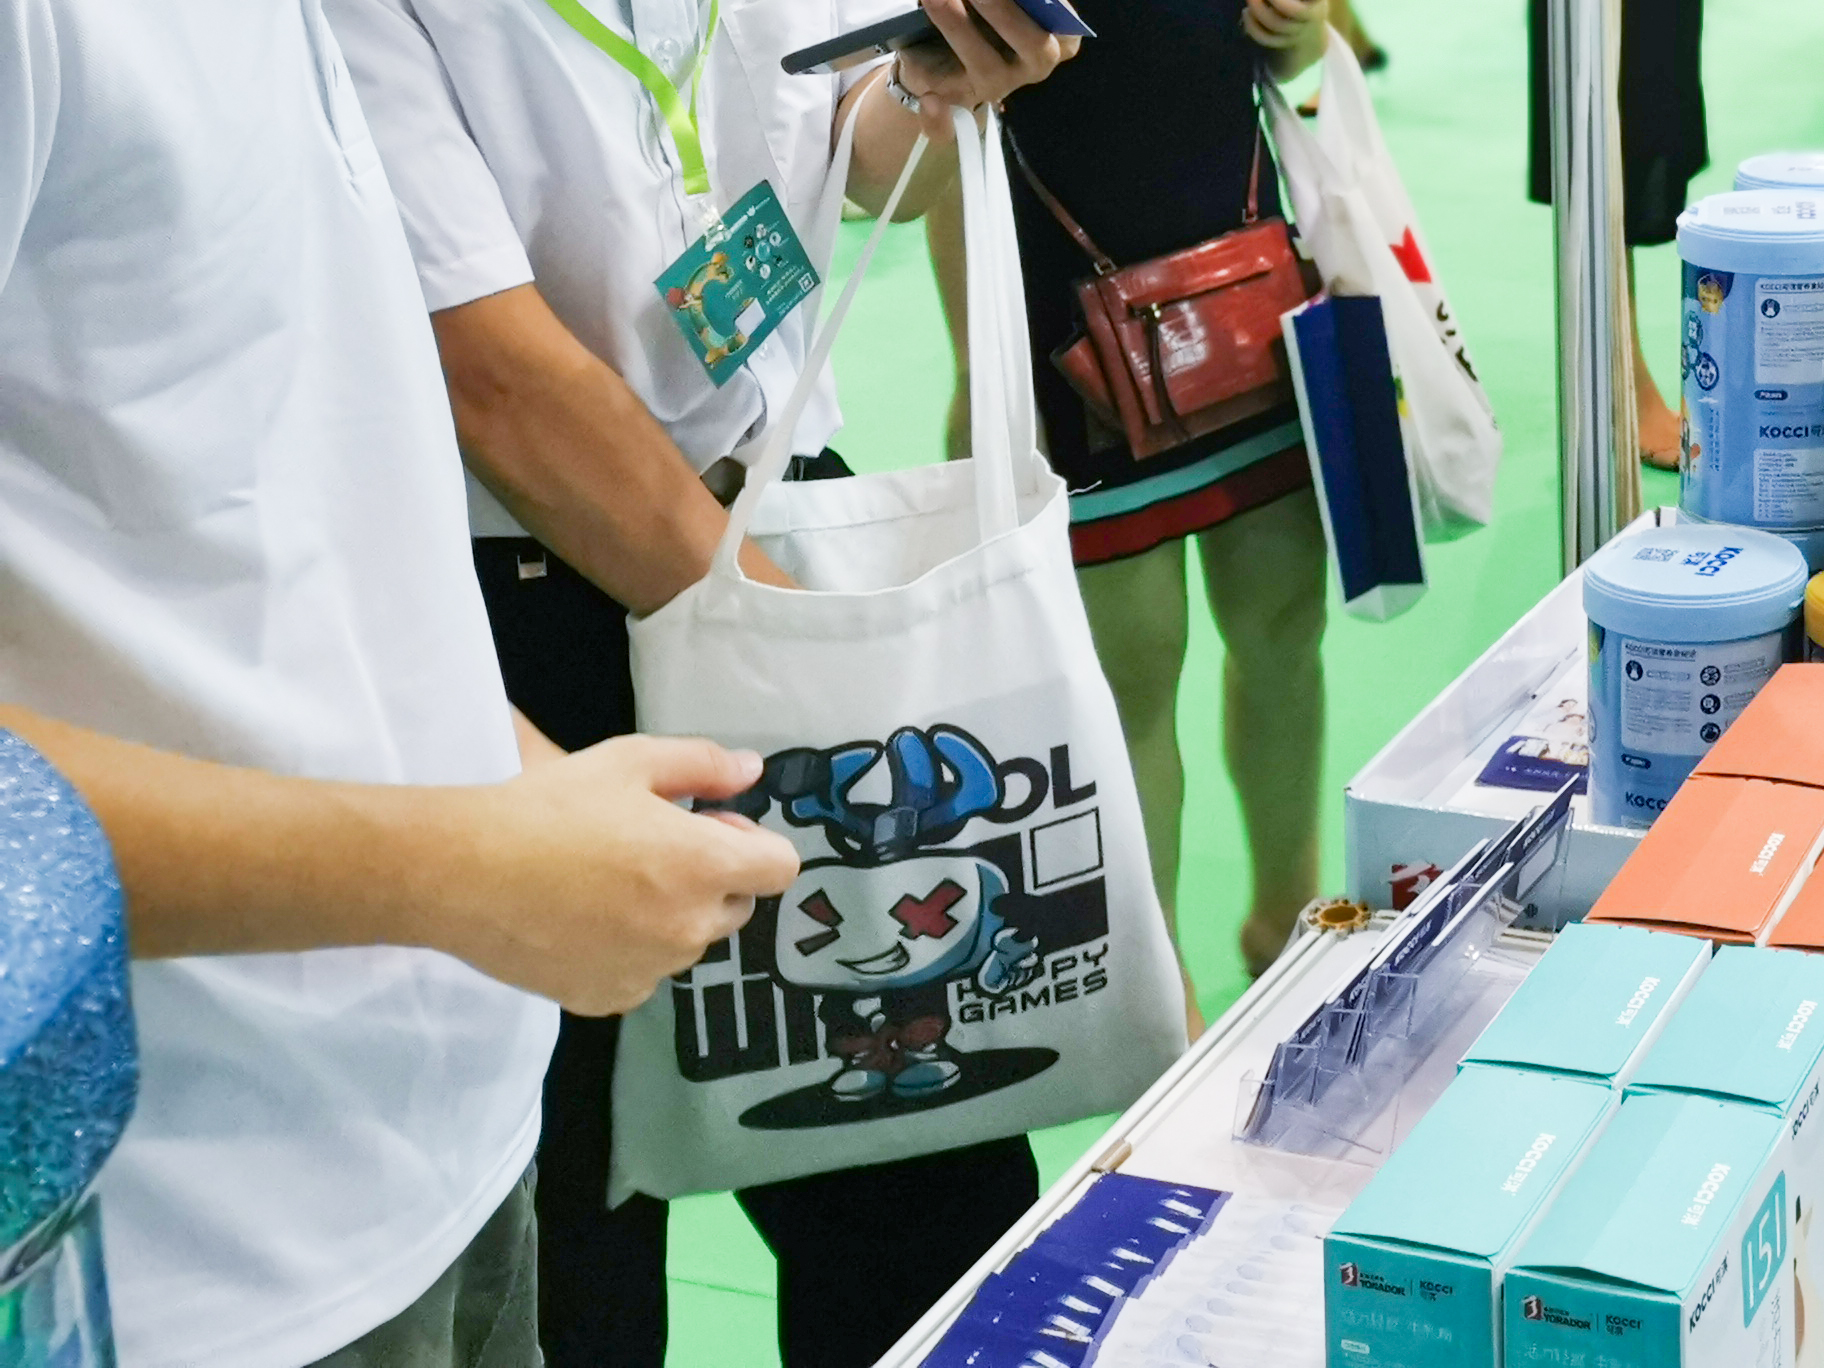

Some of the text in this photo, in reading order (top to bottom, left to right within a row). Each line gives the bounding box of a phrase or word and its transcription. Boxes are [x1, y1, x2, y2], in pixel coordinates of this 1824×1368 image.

[1695, 546, 1744, 577] KOCCI
[959, 969, 1108, 1025] GAMES
[1419, 1279, 1453, 1295] KOCCI
[1606, 1314, 1641, 1330] KOCCI
